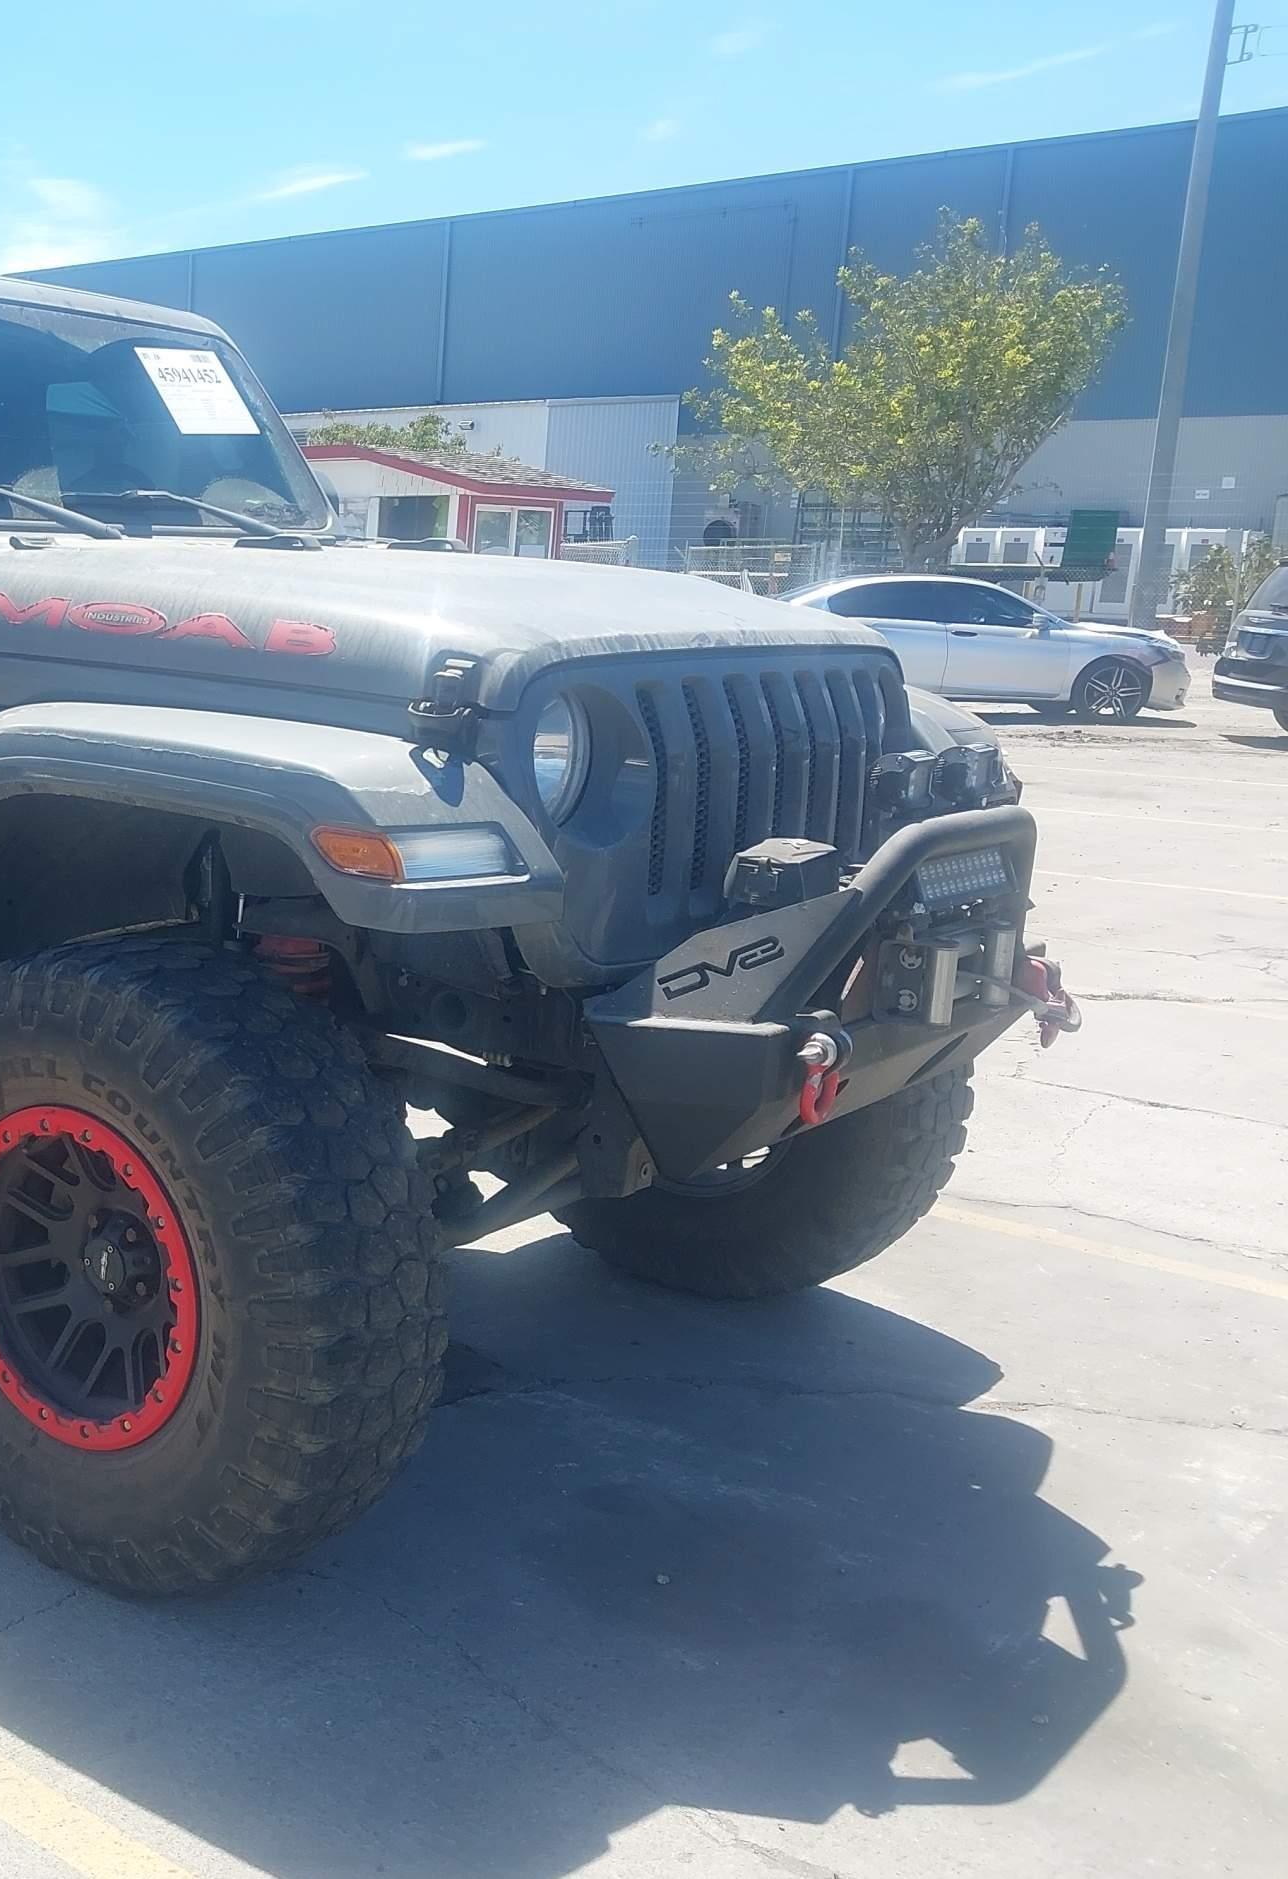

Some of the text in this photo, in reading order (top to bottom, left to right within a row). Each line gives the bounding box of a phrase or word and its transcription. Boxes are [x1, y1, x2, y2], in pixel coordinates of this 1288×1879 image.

[158, 367, 222, 384] 45941452
[82, 611, 151, 625] INDUSTRIES
[81, 1072, 228, 1312] COUNTRY
